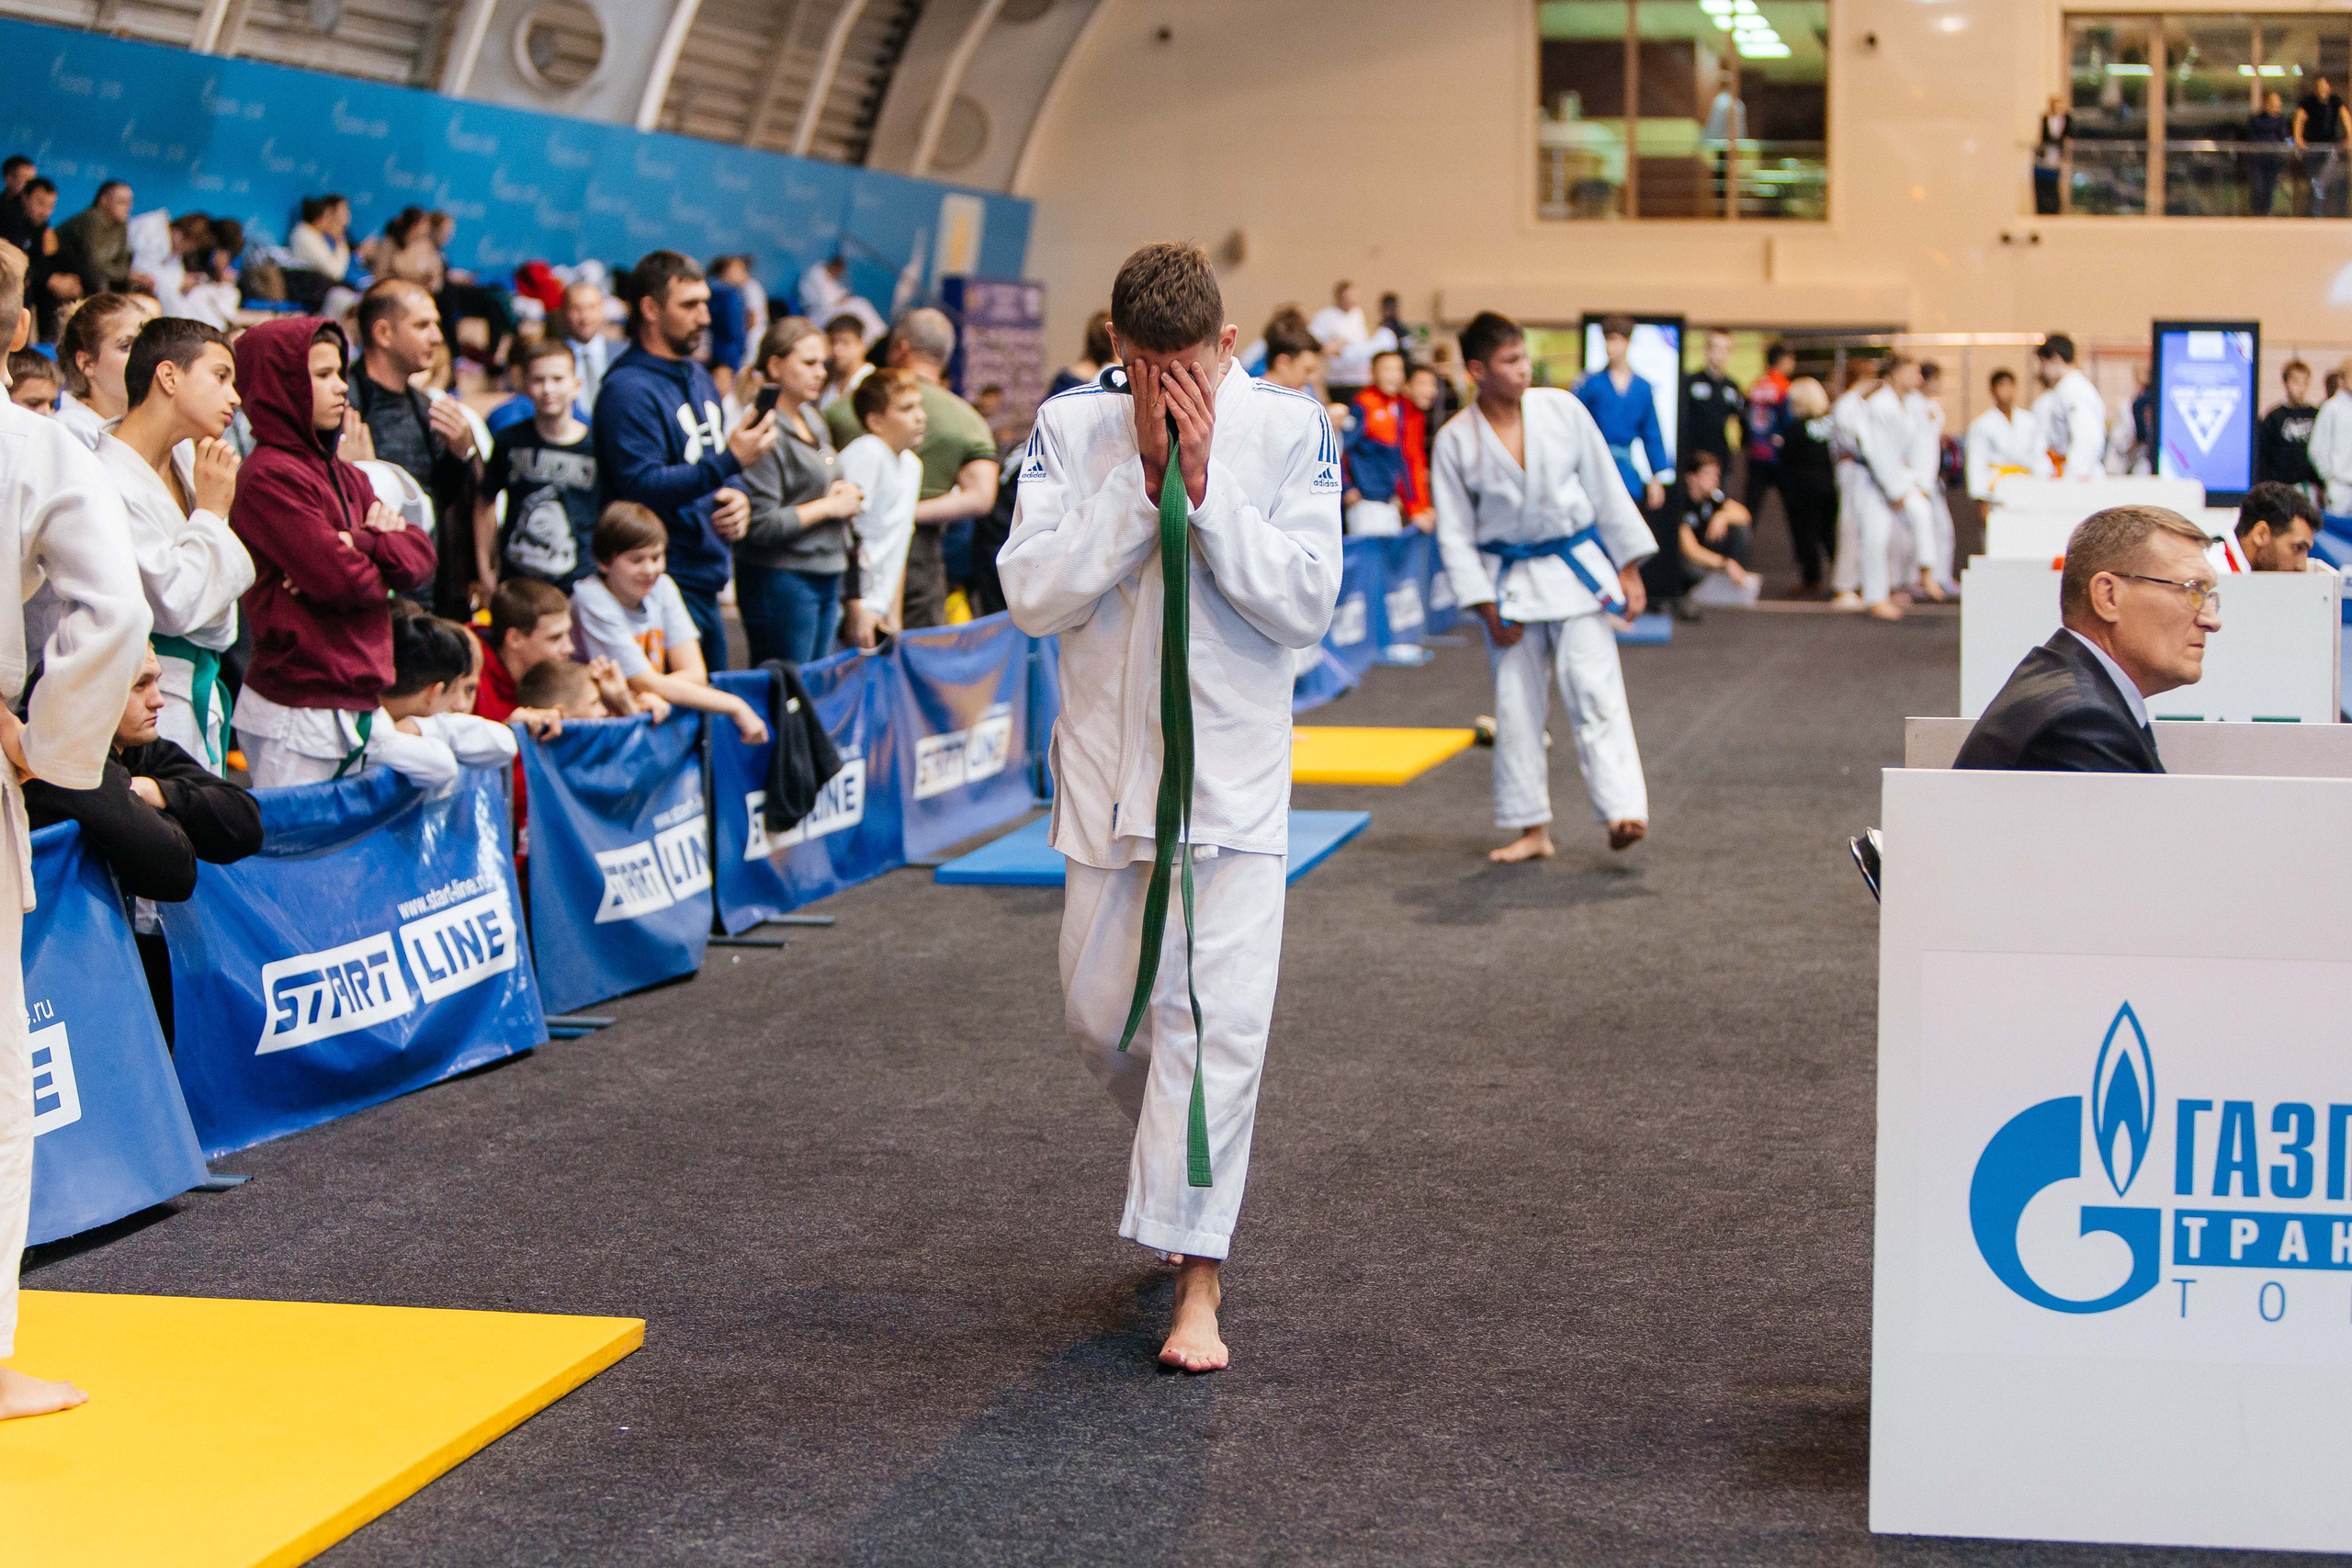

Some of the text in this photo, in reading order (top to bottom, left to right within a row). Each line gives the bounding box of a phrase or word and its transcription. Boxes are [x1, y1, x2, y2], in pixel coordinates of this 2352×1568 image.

[273, 909, 505, 1036] START LINE
[2182, 1217, 2352, 1264] ТРАН
[2172, 1279, 2352, 1322] ТО
